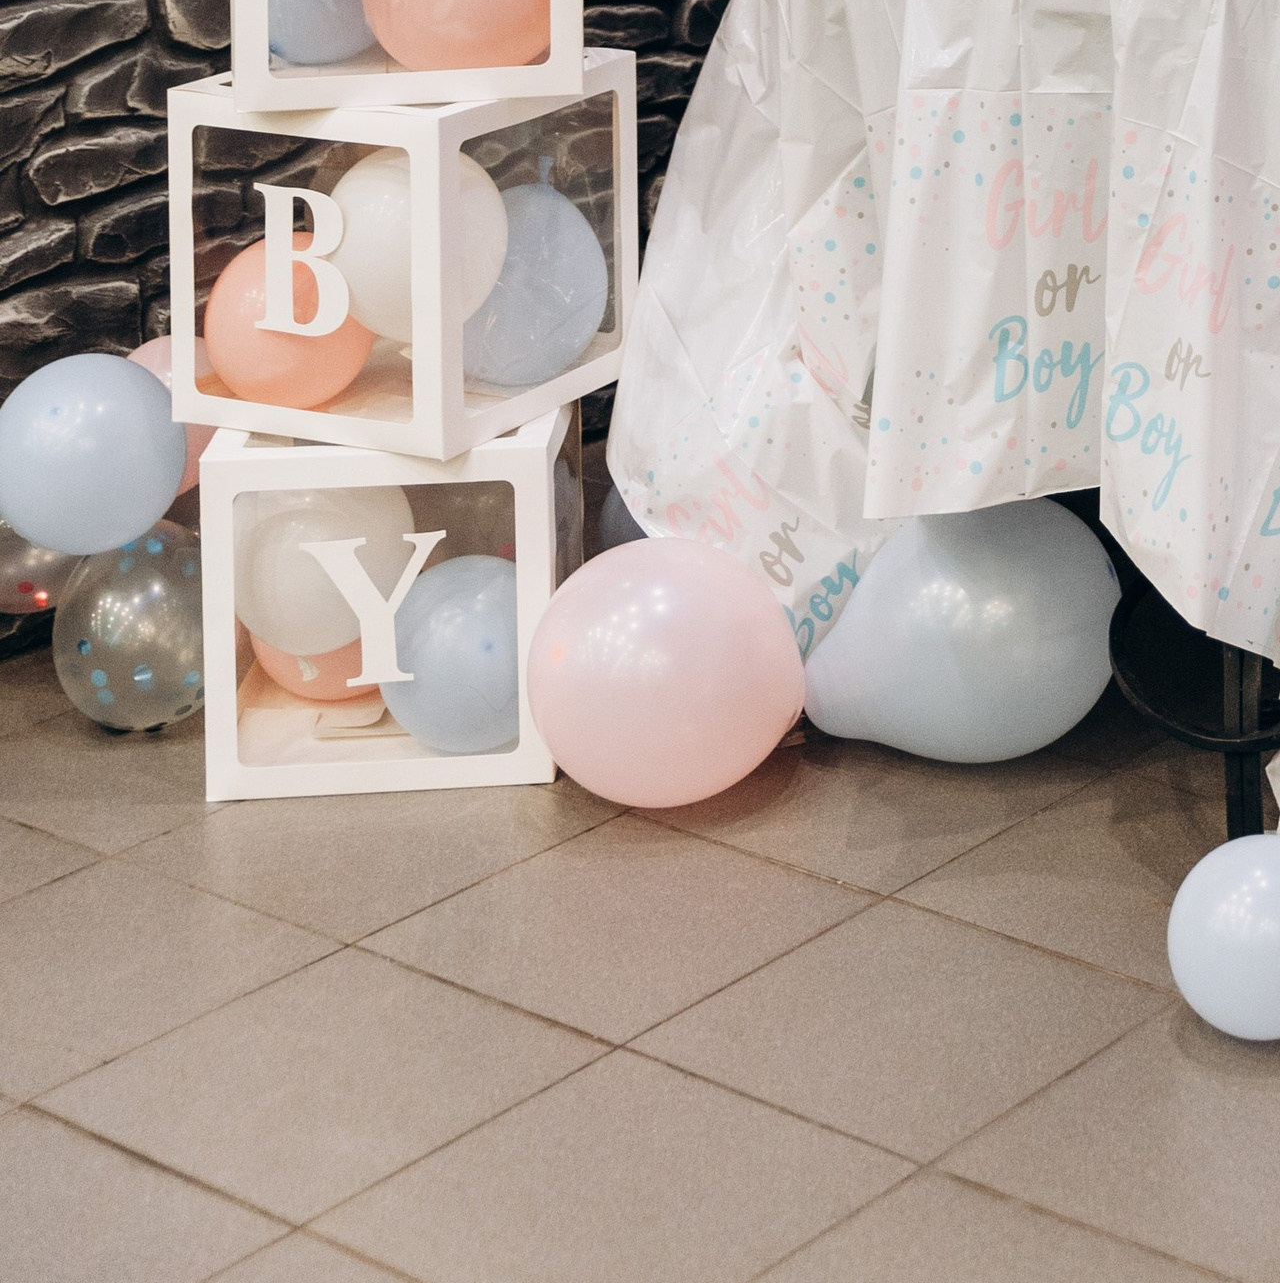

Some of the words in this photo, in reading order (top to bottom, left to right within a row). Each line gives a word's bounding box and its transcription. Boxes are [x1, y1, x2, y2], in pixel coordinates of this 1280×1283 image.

[985, 158, 1108, 250] Girl
[1034, 262, 1101, 317] or
[988, 314, 1106, 430] Boy
[1164, 336, 1212, 392] or
[1105, 361, 1192, 511] Boy
[759, 516, 806, 587] or
